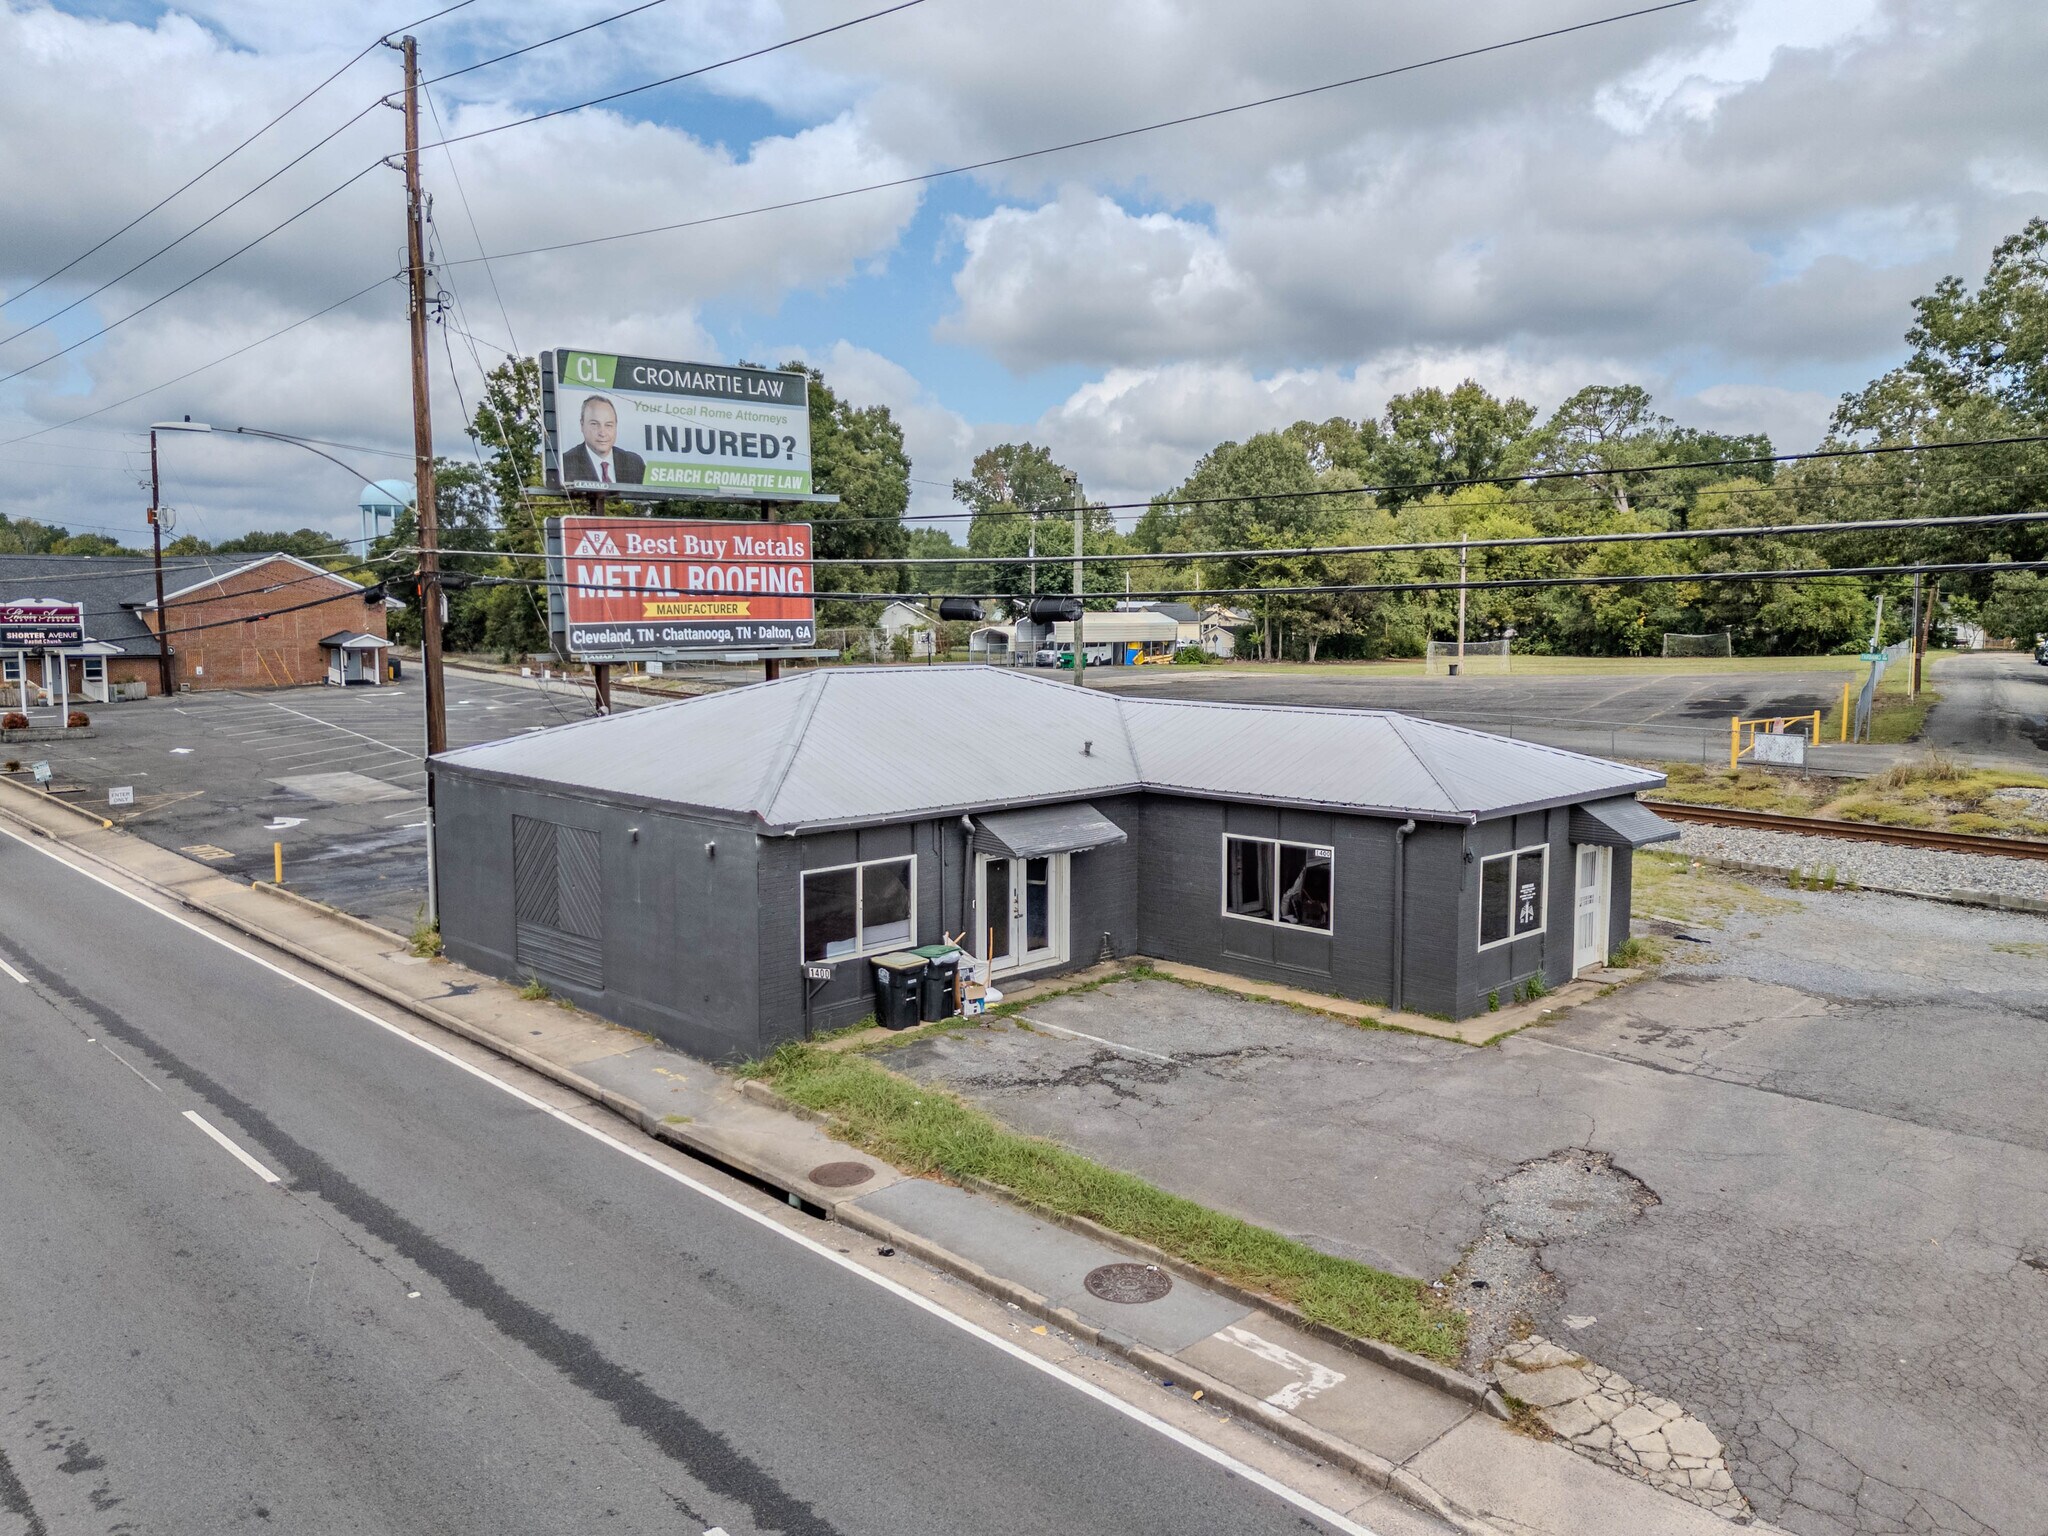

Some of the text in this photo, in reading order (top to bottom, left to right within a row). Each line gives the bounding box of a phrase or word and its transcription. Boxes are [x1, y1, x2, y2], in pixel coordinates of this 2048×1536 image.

[577, 357, 606, 383] CL
[633, 366, 784, 398] CROMARTIE LAW
[634, 400, 788, 425] Your Local Rome Attorneys
[644, 424, 797, 461] INJURED?
[650, 468, 803, 490] SEARCH CROMARTIE LAW
[625, 533, 805, 560] Best Buy Metals
[577, 565, 805, 598] METAL ROOFING
[656, 603, 738, 615] MANUFACTURER
[48, 631, 78, 639] AVENUE
[572, 625, 811, 645] Cleveland, TN Chattanooga, TN Dalton, GA
[810, 968, 830, 978] 1400
